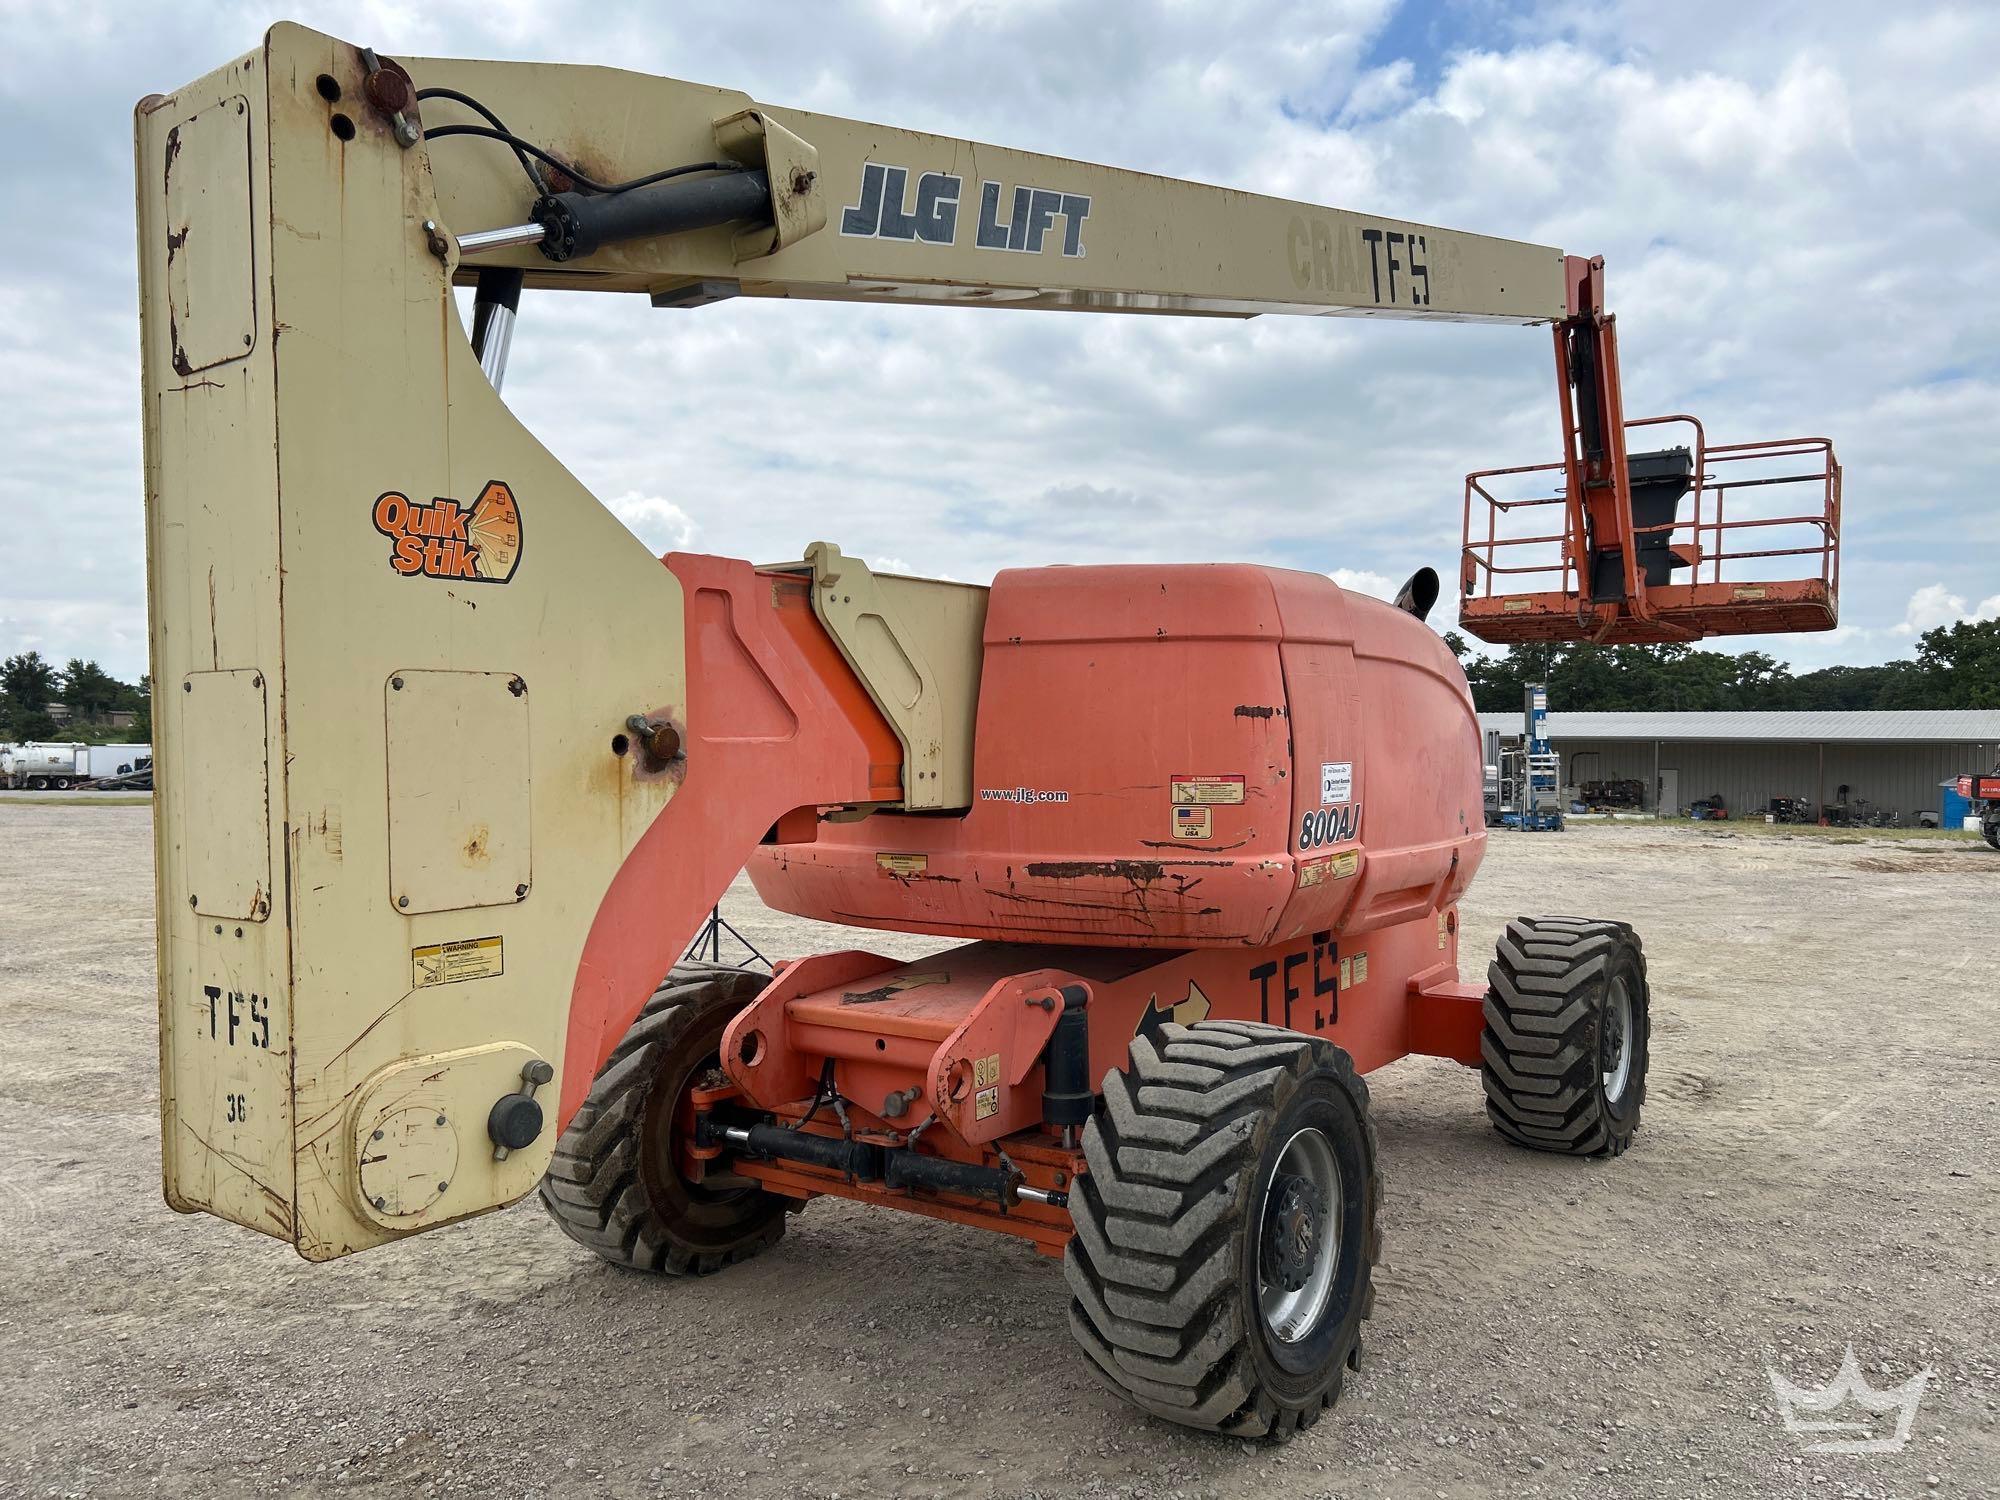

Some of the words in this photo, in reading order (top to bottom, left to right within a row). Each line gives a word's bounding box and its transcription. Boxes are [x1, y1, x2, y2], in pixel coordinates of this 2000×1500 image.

[840, 161, 963, 246] JLG
[975, 180, 1091, 258] LIFT
[1362, 229, 1430, 305] TFS
[374, 494, 471, 540] Quik
[392, 535, 479, 577] Stik
[980, 787, 1068, 804] www.jlg.com
[1299, 803, 1360, 851] 800AJ
[446, 942, 479, 953] WARNING
[227, 1093, 246, 1123] 36
